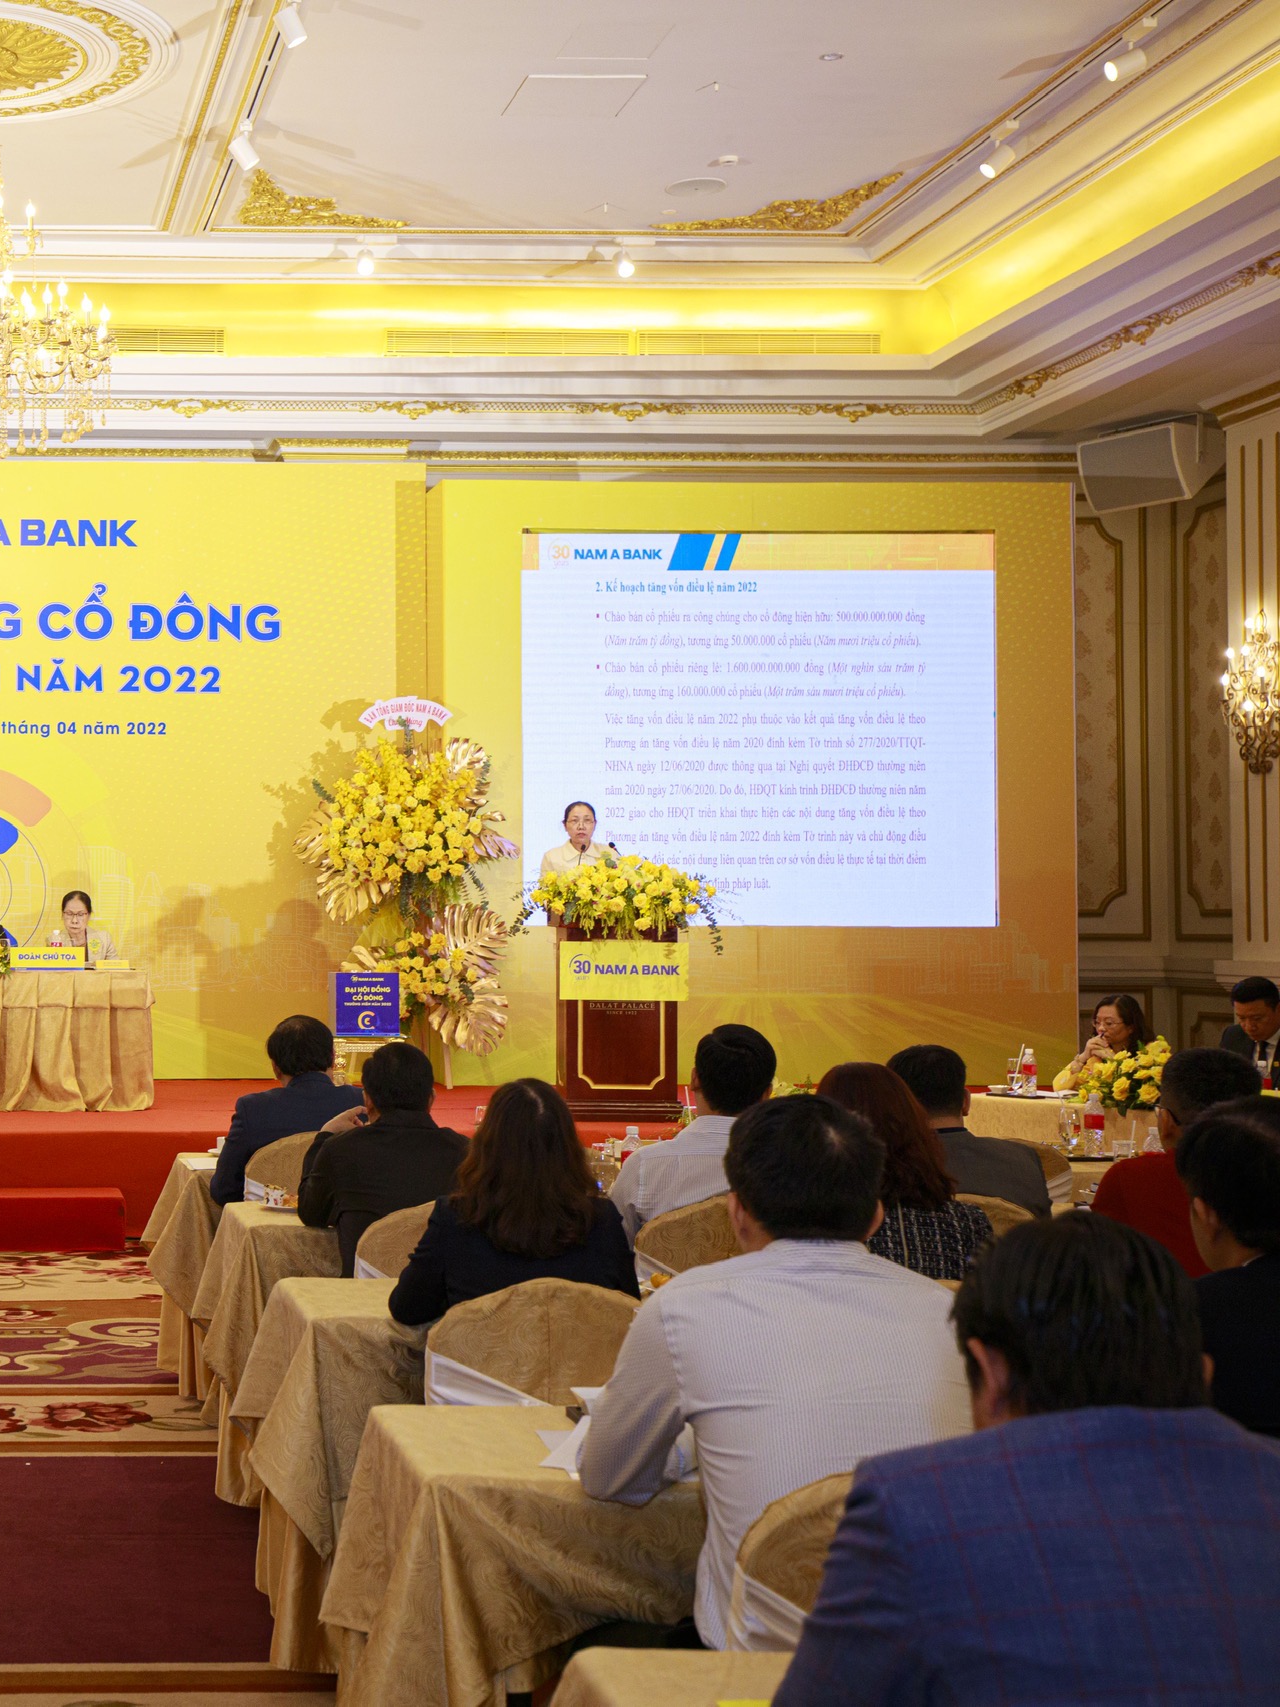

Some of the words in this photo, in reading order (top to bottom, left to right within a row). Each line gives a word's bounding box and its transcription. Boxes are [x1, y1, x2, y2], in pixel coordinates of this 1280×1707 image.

[20, 519, 137, 547] BANK
[552, 545, 570, 559] 30
[574, 549, 607, 560] NAM
[610, 549, 620, 560] A
[623, 549, 662, 560] BANK
[596, 581, 603, 592] 2.
[606, 578, 617, 592] Kế
[620, 581, 645, 595] hoạch
[647, 581, 666, 595] tăng
[669, 578, 684, 592] vốn
[686, 578, 705, 592] điều
[707, 581, 714, 595] lệ
[716, 581, 735, 592] năm
[738, 581, 757, 592] 2022
[37, 582, 114, 641] CỔ
[128, 591, 282, 643] ĐÔNG
[15, 657, 104, 693] NĂM
[119, 665, 221, 694] 2022
[416, 703, 427, 713] NAM
[432, 707, 448, 720] BANK
[1, 720, 51, 737] tháng
[57, 722, 77, 734] 04
[83, 721, 120, 735] năm
[127, 722, 167, 735] 2022
[625, 784, 645, 795] 2020
[670, 784, 716, 795] 27/06/2020.
[719, 784, 732, 795] Do
[573, 960, 591, 974] 30
[595, 964, 627, 975] NAM
[630, 965, 639, 975] A
[642, 965, 680, 976] BANK
